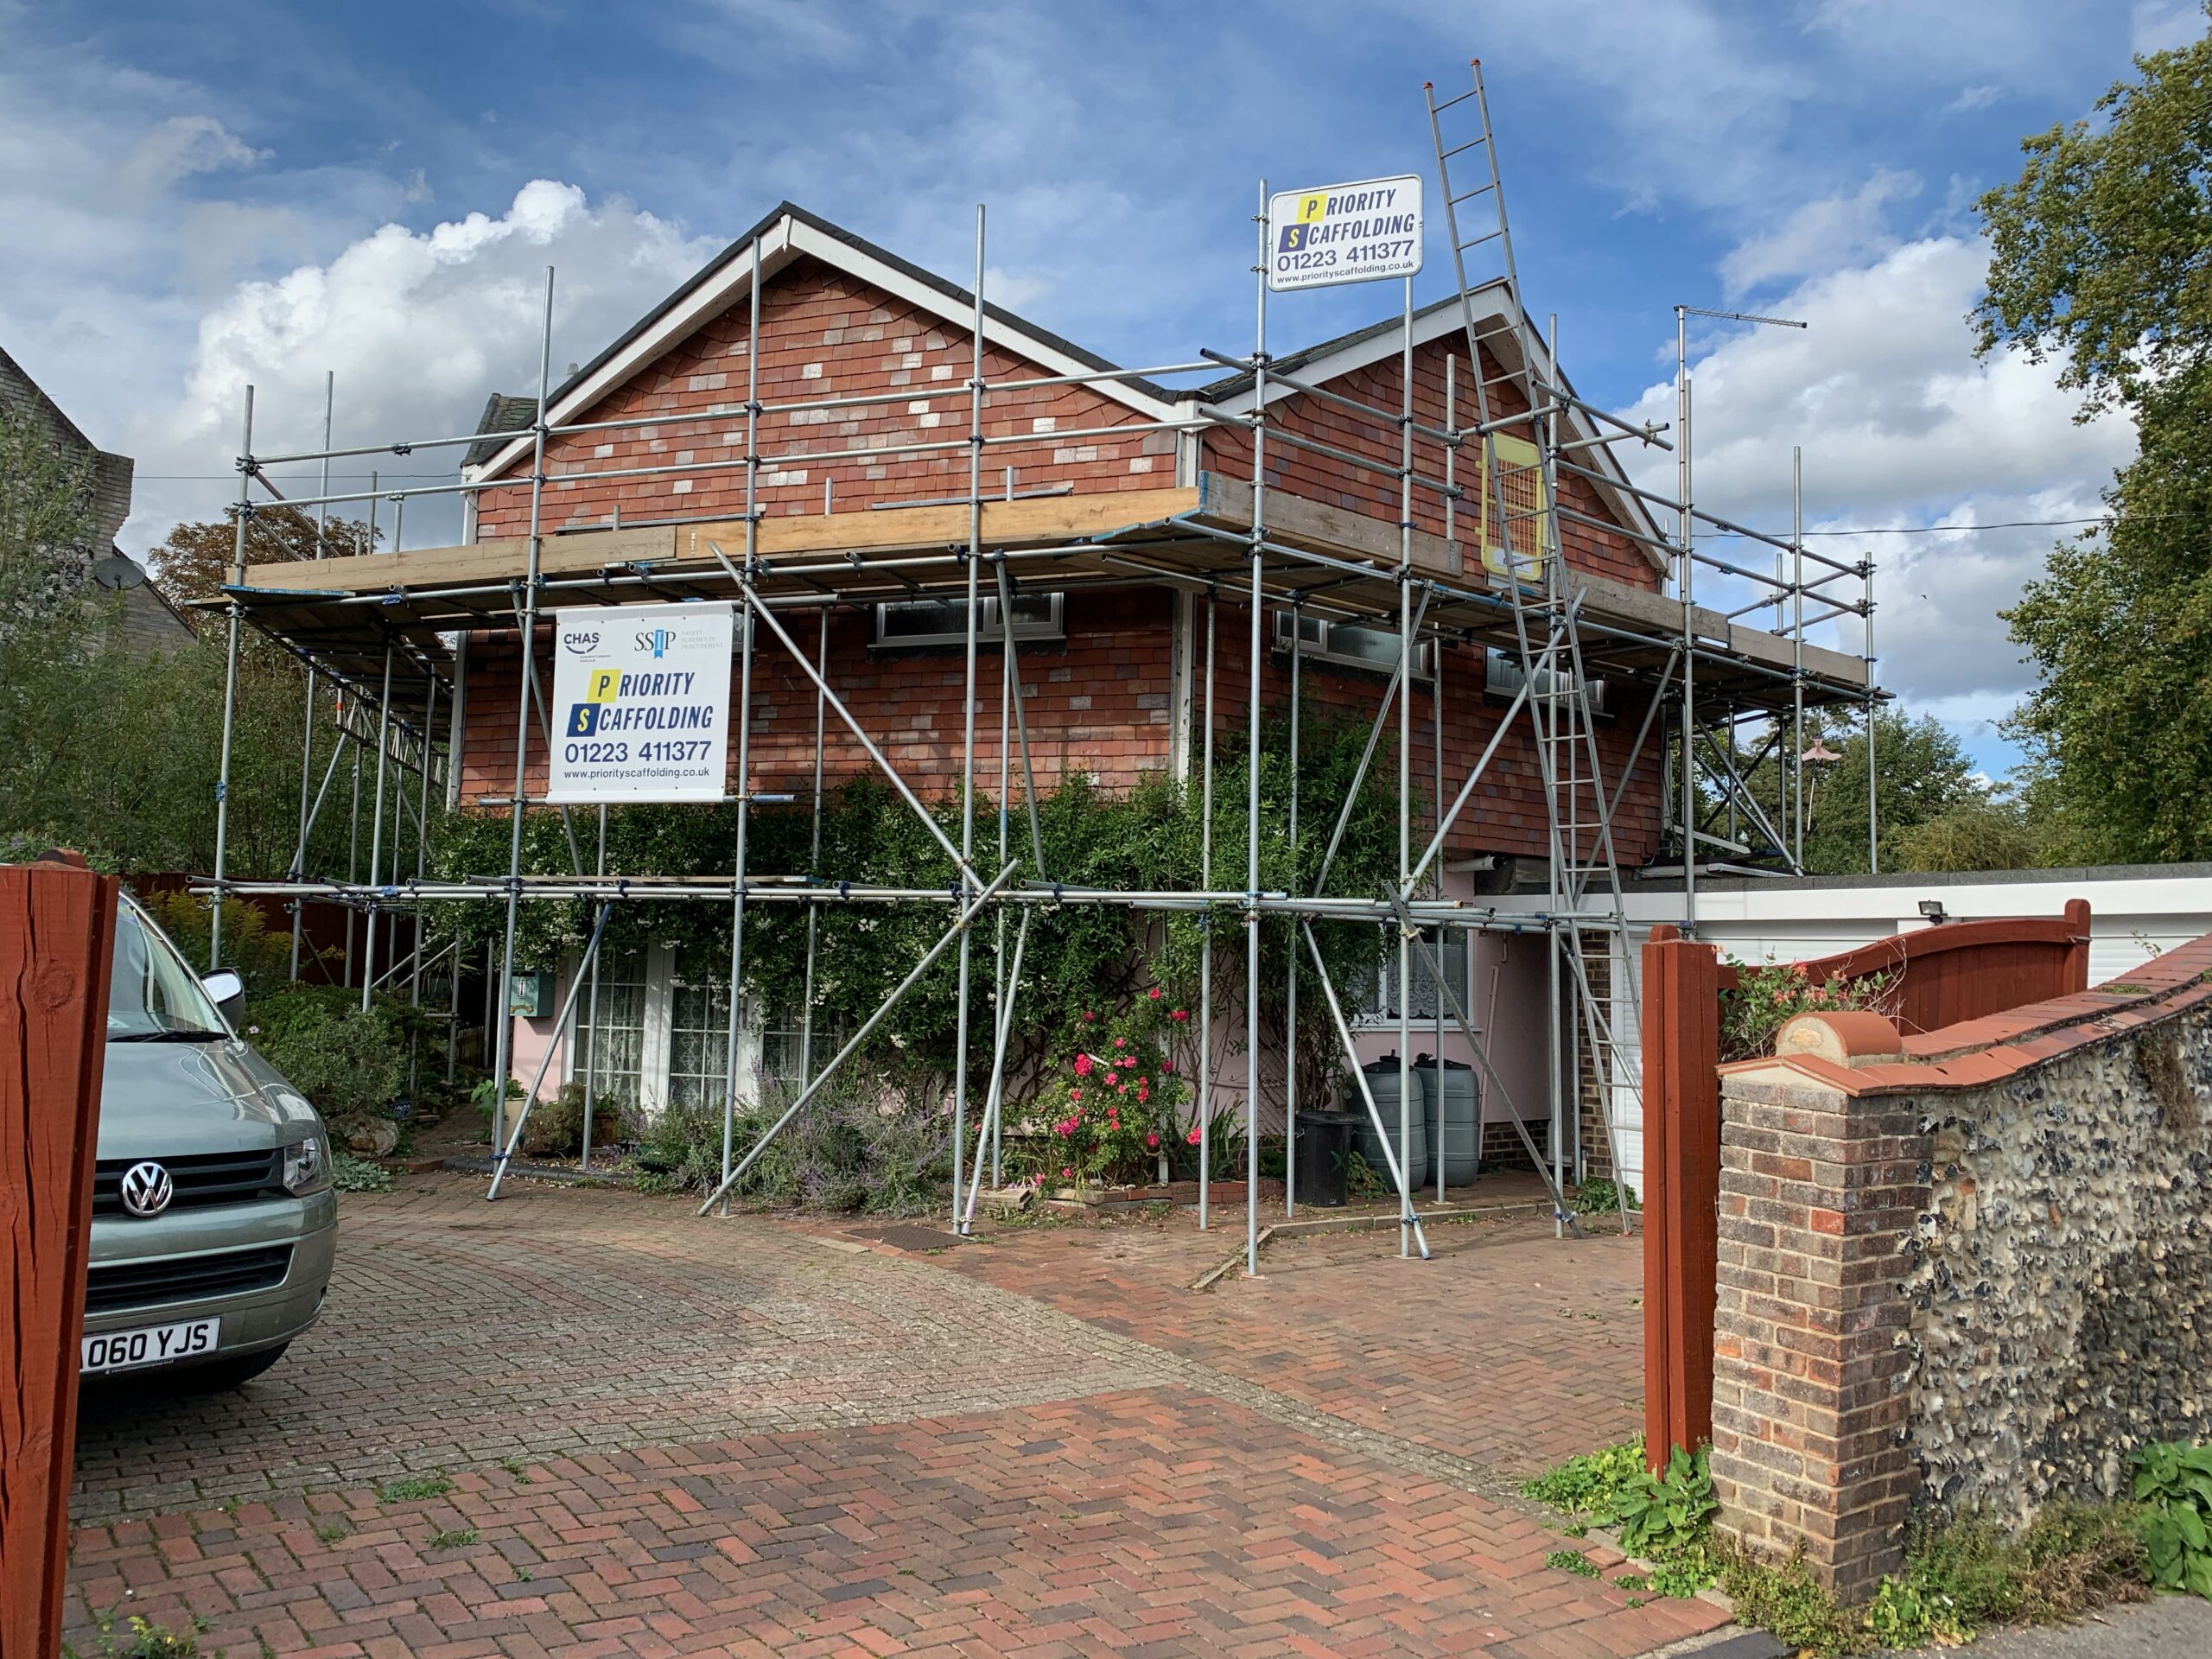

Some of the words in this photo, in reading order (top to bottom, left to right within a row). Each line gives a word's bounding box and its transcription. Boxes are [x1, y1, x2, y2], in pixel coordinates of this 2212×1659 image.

[1306, 188, 1396, 219] PRIORITY
[1288, 213, 1415, 248] SCAFFOLDING
[1277, 250, 1337, 272] 01223
[1346, 239, 1414, 263] 411377
[1277, 260, 1414, 283] www.priorityscaffolding.co.uk
[563, 632, 600, 645] CHAS
[634, 631, 676, 652] SSIP
[597, 672, 696, 697] PRIORITY
[577, 705, 714, 733] SCAFFOLDING
[564, 742, 628, 763] 01223
[639, 741, 712, 761] 411377
[564, 767, 709, 779] www.priorityscaffolding.co.uk
[157, 1324, 209, 1357] YJS
